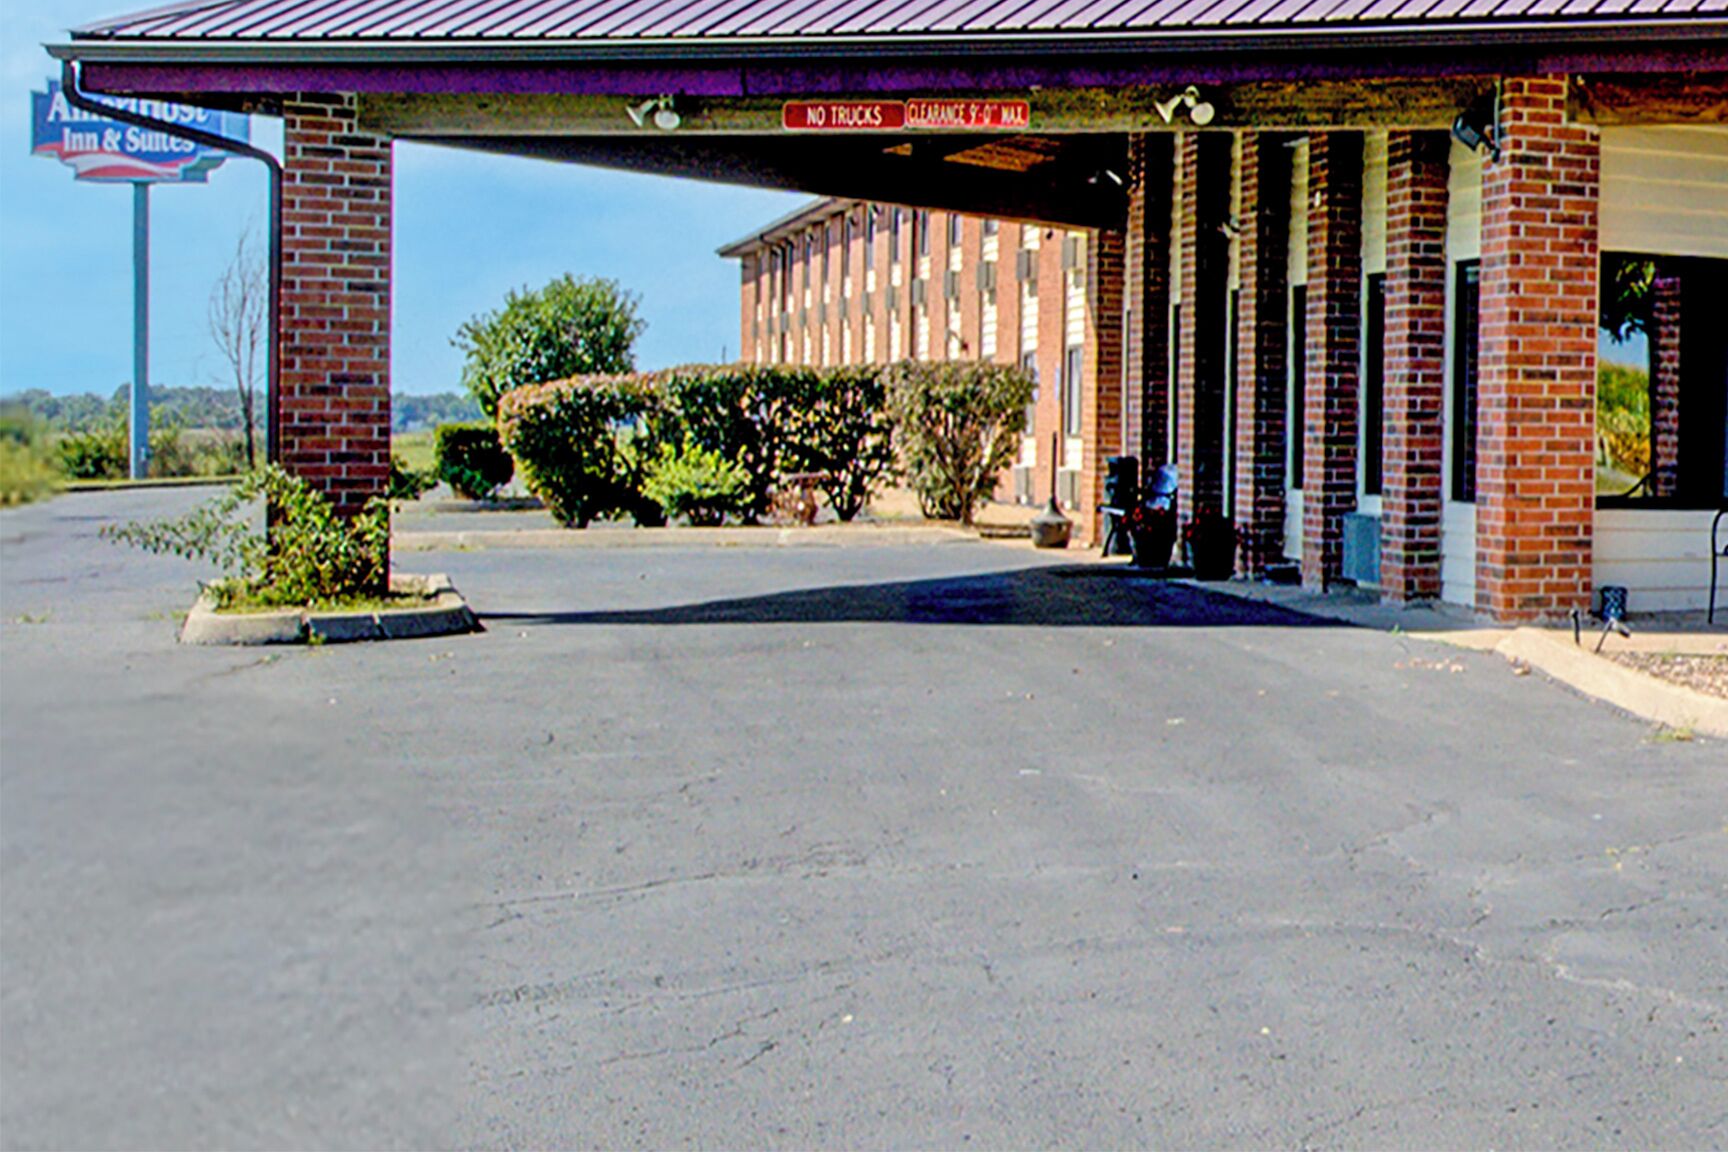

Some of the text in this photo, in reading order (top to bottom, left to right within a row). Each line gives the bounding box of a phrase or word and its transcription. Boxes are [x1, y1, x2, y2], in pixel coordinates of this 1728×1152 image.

[806, 105, 883, 127] NO TRUCKS
[908, 103, 966, 126] CLEARANCE
[62, 126, 195, 153] Inn & Suites
